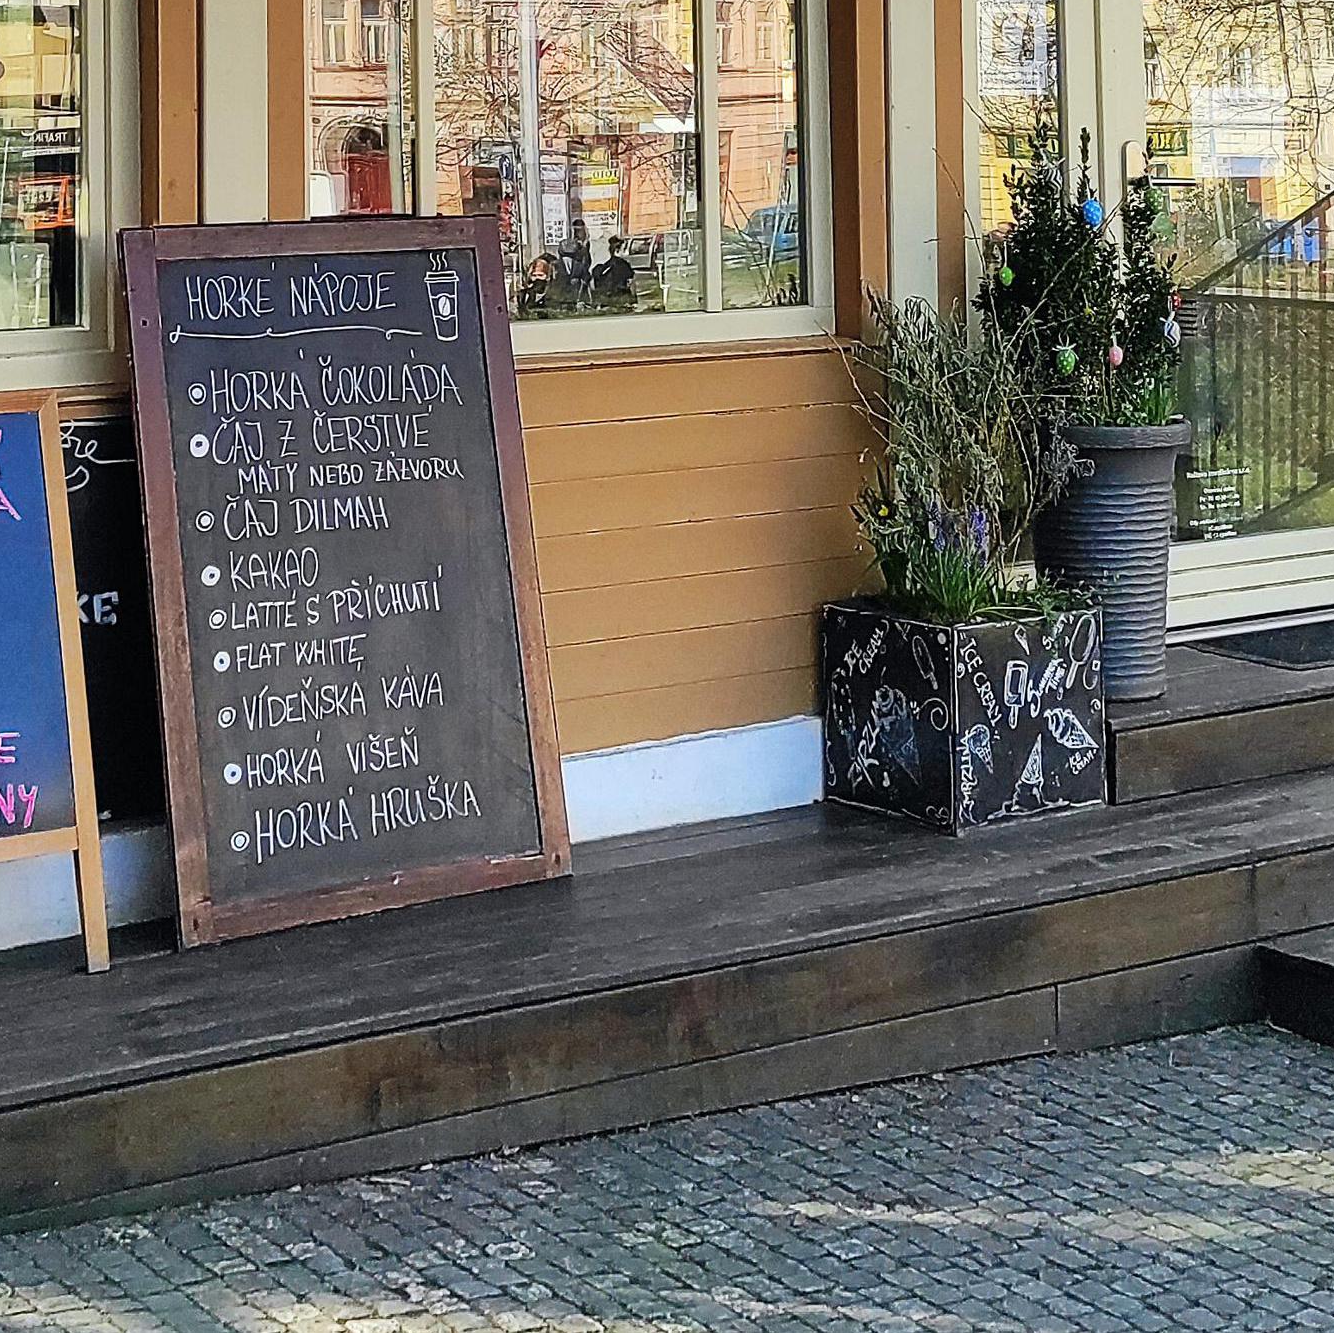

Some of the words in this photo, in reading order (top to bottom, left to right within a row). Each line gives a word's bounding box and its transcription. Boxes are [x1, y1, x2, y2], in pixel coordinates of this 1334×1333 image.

[184, 263, 275, 323] HORKÉ
[290, 264, 397, 318] NÁPOJE
[208, 349, 308, 413] HORKÁ
[320, 350, 463, 408] ČOKOLÁDA
[211, 417, 265, 463] ČAJ
[278, 421, 297, 457] Z
[312, 405, 431, 454] ČERSTVÉ
[238, 461, 298, 494] MÁTY
[309, 463, 364, 486] NEBO
[373, 452, 465, 483] ZÁZVORU
[222, 493, 279, 542] ČAJ
[293, 496, 389, 534] DILMAH
[229, 547, 320, 591] KAKAO
[306, 598, 321, 626] S
[326, 565, 443, 625] PŘÍCHUTÍ
[235, 642, 286, 671] FLAT
[858, 625, 885, 674] CREAM
[242, 677, 368, 731] VÍDEŇSKÁ
[381, 666, 445, 709] KÁVA
[959, 638, 984, 673] ICE
[973, 670, 1003, 727] CREAM
[246, 730, 325, 788] HORKÁ
[346, 727, 420, 774] VIŠEŇ
[957, 729, 979, 824] ZMRZLINA
[1071, 752, 1094, 775] CREAM
[255, 785, 358, 864] HORKÁ
[370, 776, 482, 836] HRUŠKA
